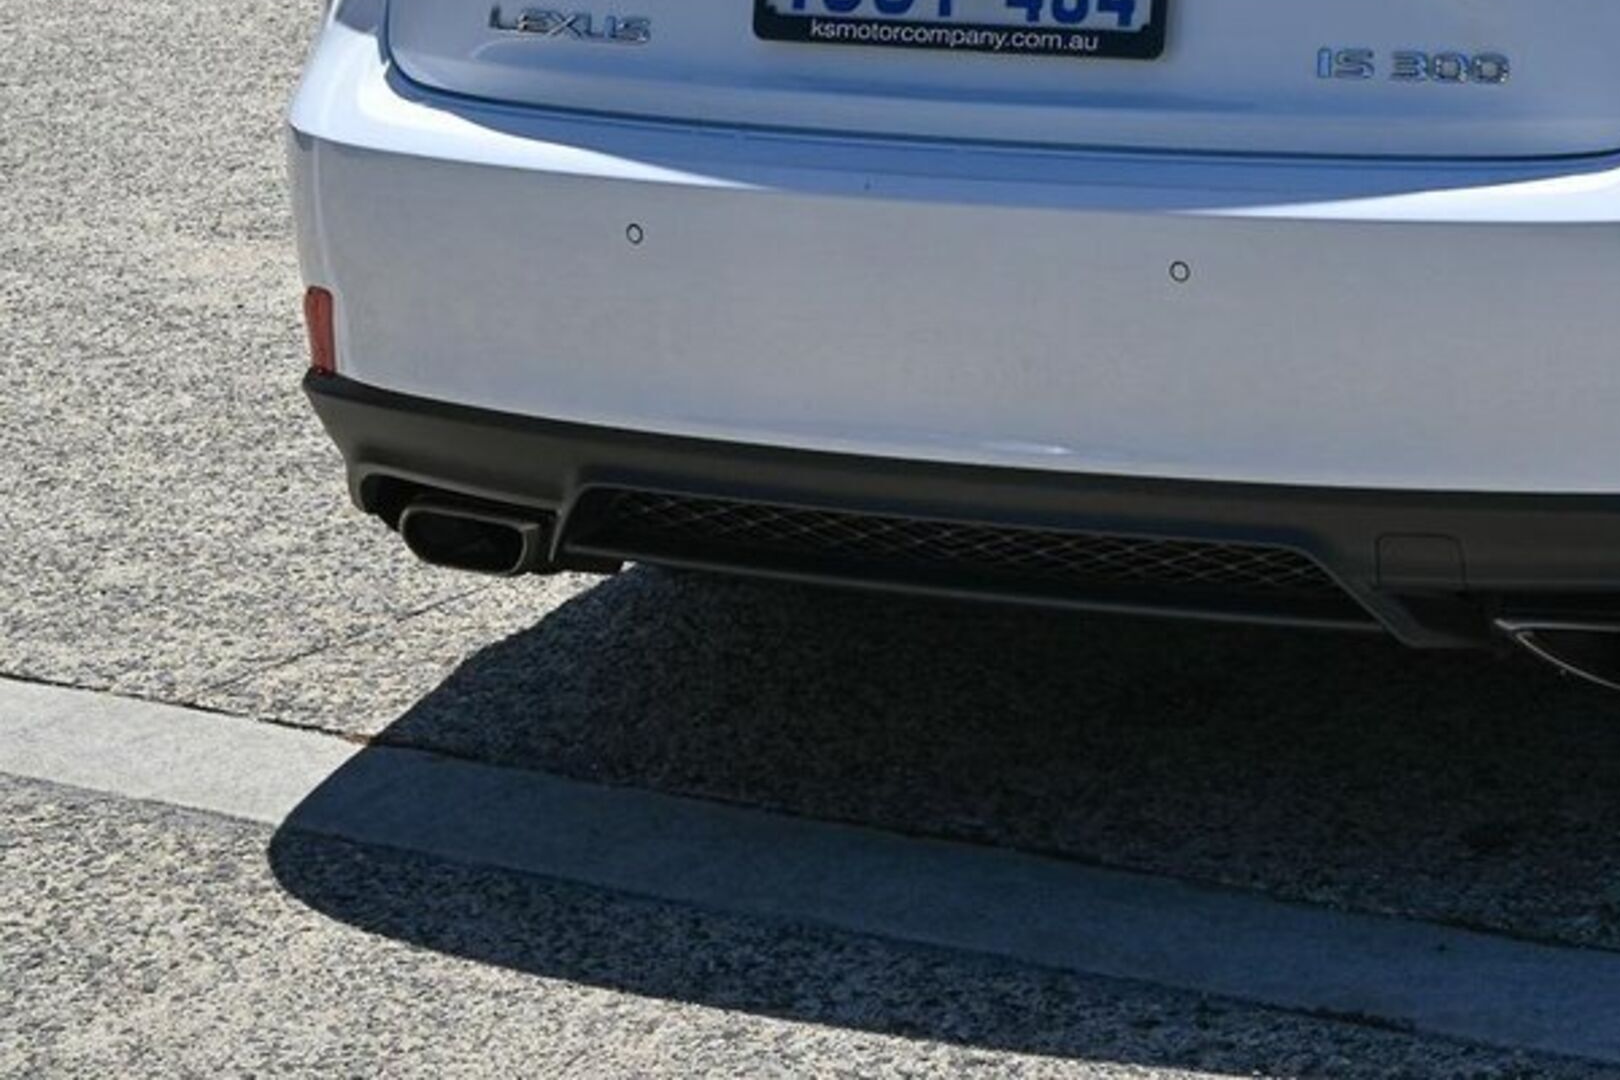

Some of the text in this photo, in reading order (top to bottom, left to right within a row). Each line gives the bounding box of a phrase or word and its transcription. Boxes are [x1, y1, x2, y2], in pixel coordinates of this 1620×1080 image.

[488, 4, 652, 45] LEXUS
[809, 18, 1100, 52] ksmotorcompany.com.au
[1316, 47, 1511, 85] IS 300
